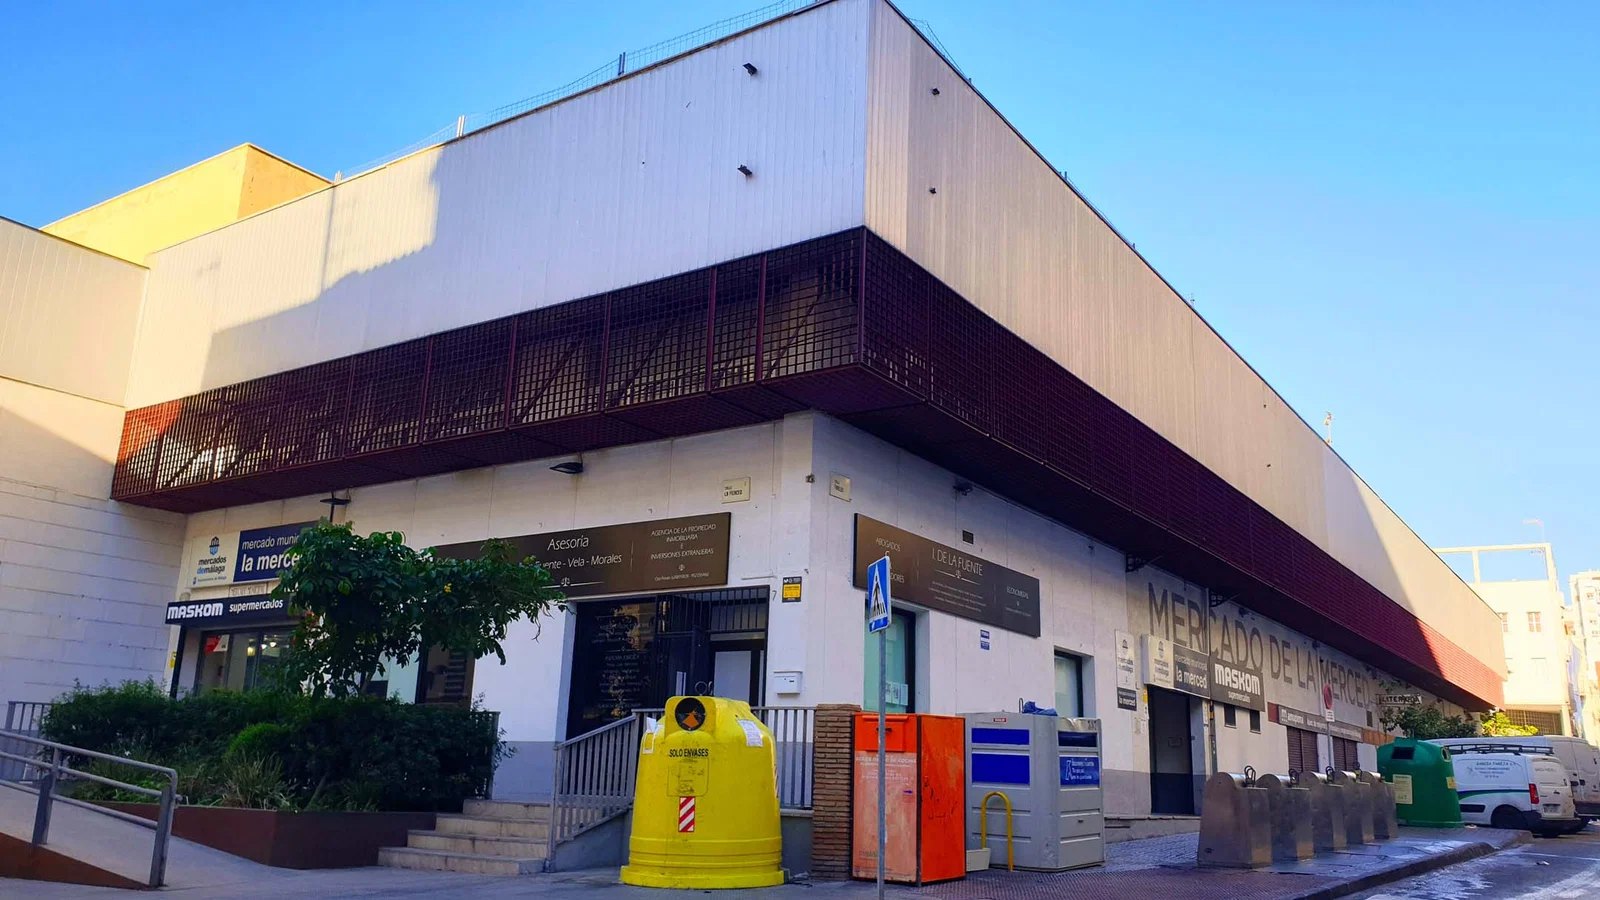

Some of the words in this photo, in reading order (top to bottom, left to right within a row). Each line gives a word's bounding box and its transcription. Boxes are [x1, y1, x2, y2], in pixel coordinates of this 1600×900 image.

[651, 529, 672, 537] AGENCIA
[688, 524, 716, 532] PROPIEDAD
[666, 534, 698, 542] INMOBILIARIA
[242, 536, 275, 550] mercado
[547, 535, 589, 550] Asesoría
[876, 537, 901, 552] ABOGADOS
[198, 555, 227, 566] mercados
[568, 557, 585, 567] Vela
[591, 553, 622, 566] Morales
[651, 552, 680, 560] INVERSIONES
[682, 548, 714, 556] EXTRANJERAS
[241, 554, 253, 572] la
[937, 549, 947, 563] DE
[948, 551, 957, 566] LA
[959, 556, 983, 576] FUENTE
[167, 602, 224, 619] MASKOM
[229, 598, 283, 614] supermercados
[1148, 581, 1263, 673] MERCADO
[1269, 634, 1293, 685] DE
[1296, 646, 1317, 692] LA
[1320, 657, 1371, 709] MERCED
[1175, 665, 1183, 682] la
[1183, 671, 1207, 689] merced
[1214, 663, 1260, 696] MASKOM
[669, 749, 683, 757] SOLO
[684, 748, 709, 757] ENVASES
